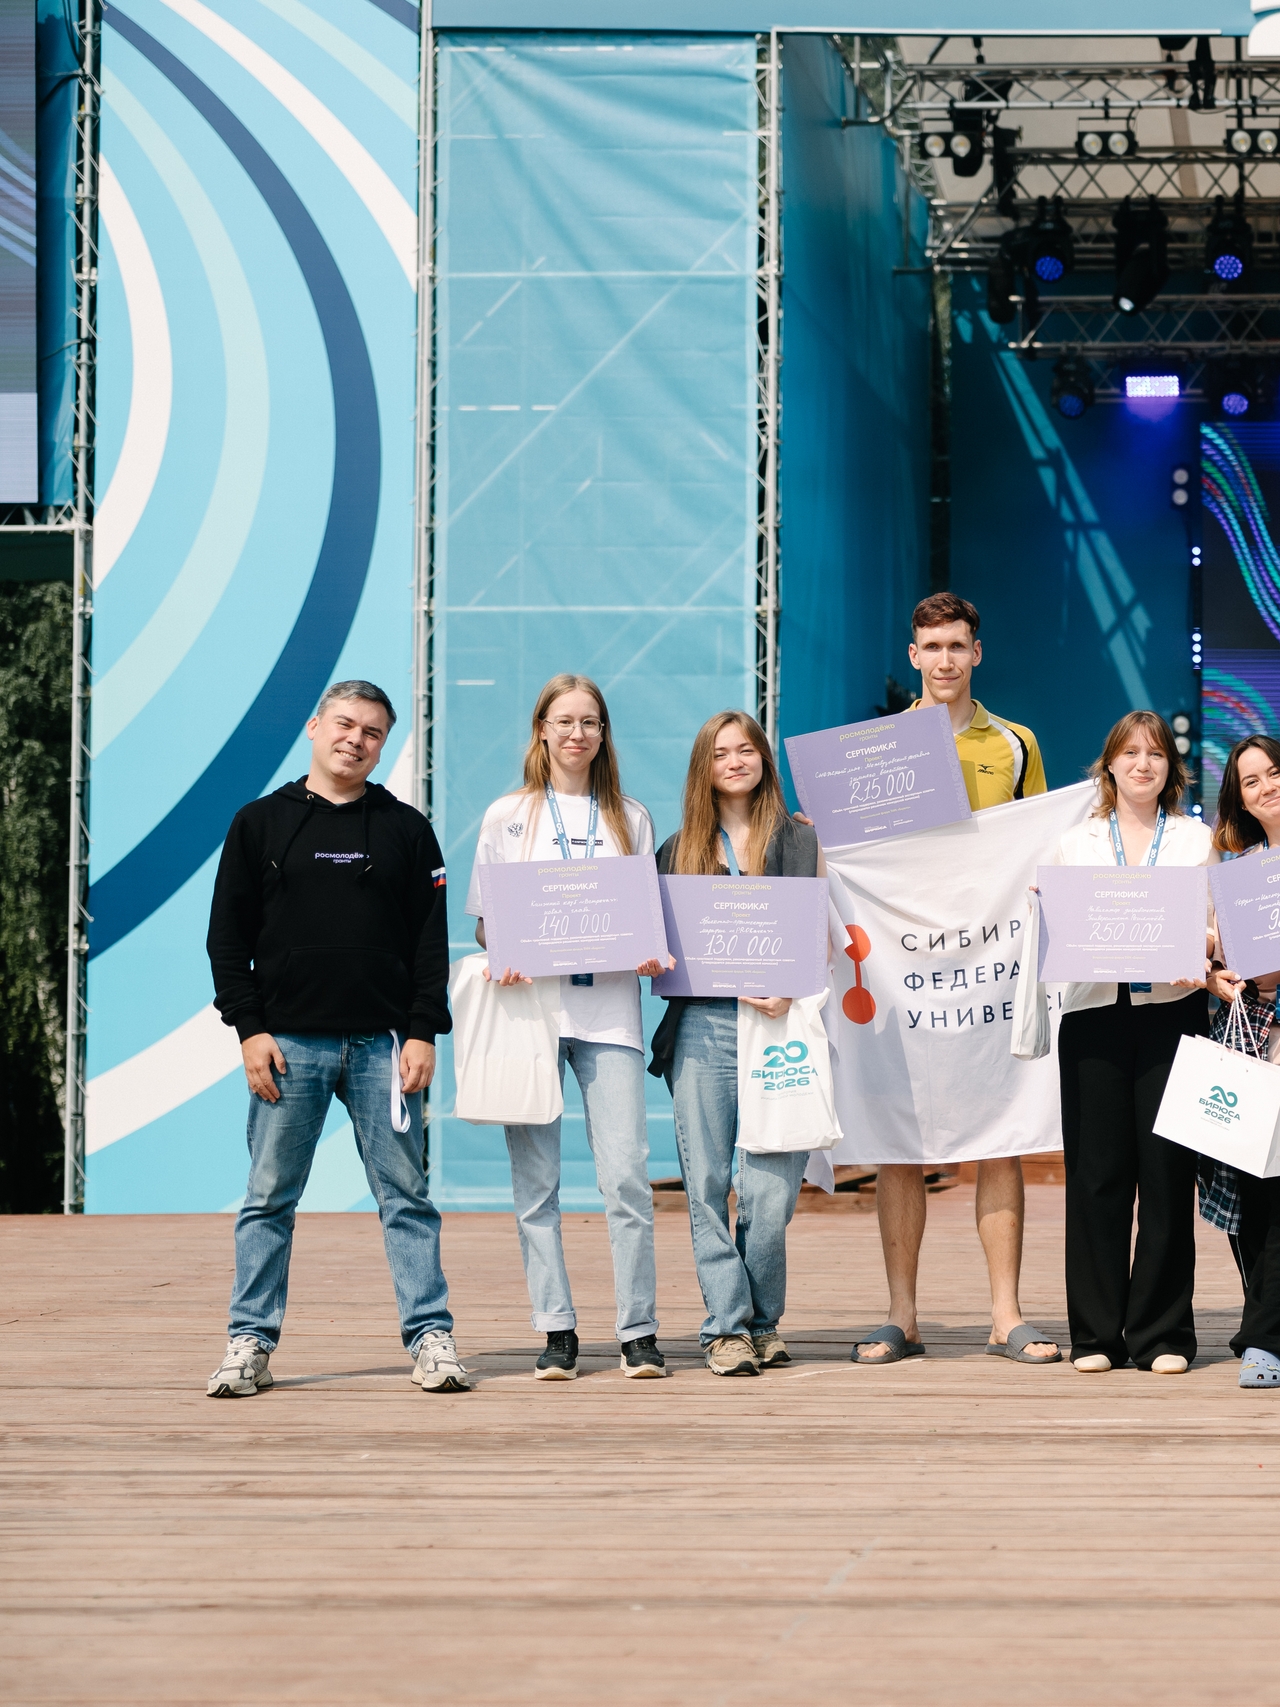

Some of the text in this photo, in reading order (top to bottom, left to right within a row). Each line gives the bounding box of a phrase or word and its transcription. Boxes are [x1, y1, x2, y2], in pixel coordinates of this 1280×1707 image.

[846, 741, 898, 759] СЕРТИФИКАТ
[886, 770, 915, 796] 000
[543, 883, 599, 893] СЕРТИФИКАТ
[712, 883, 771, 891] росмолодёжь
[714, 902, 769, 910] СЕРТИФИКАТ
[539, 913, 611, 938] 140 000
[901, 919, 1023, 952] СИБИР
[1090, 923, 1163, 943] 250 000
[703, 935, 783, 956] 130 000
[904, 960, 1021, 992] ФЕДЕРА
[764, 1076, 810, 1091] 2026
[1198, 1098, 1241, 1121] БИРЮСА
[1204, 1108, 1232, 1125] 2026
